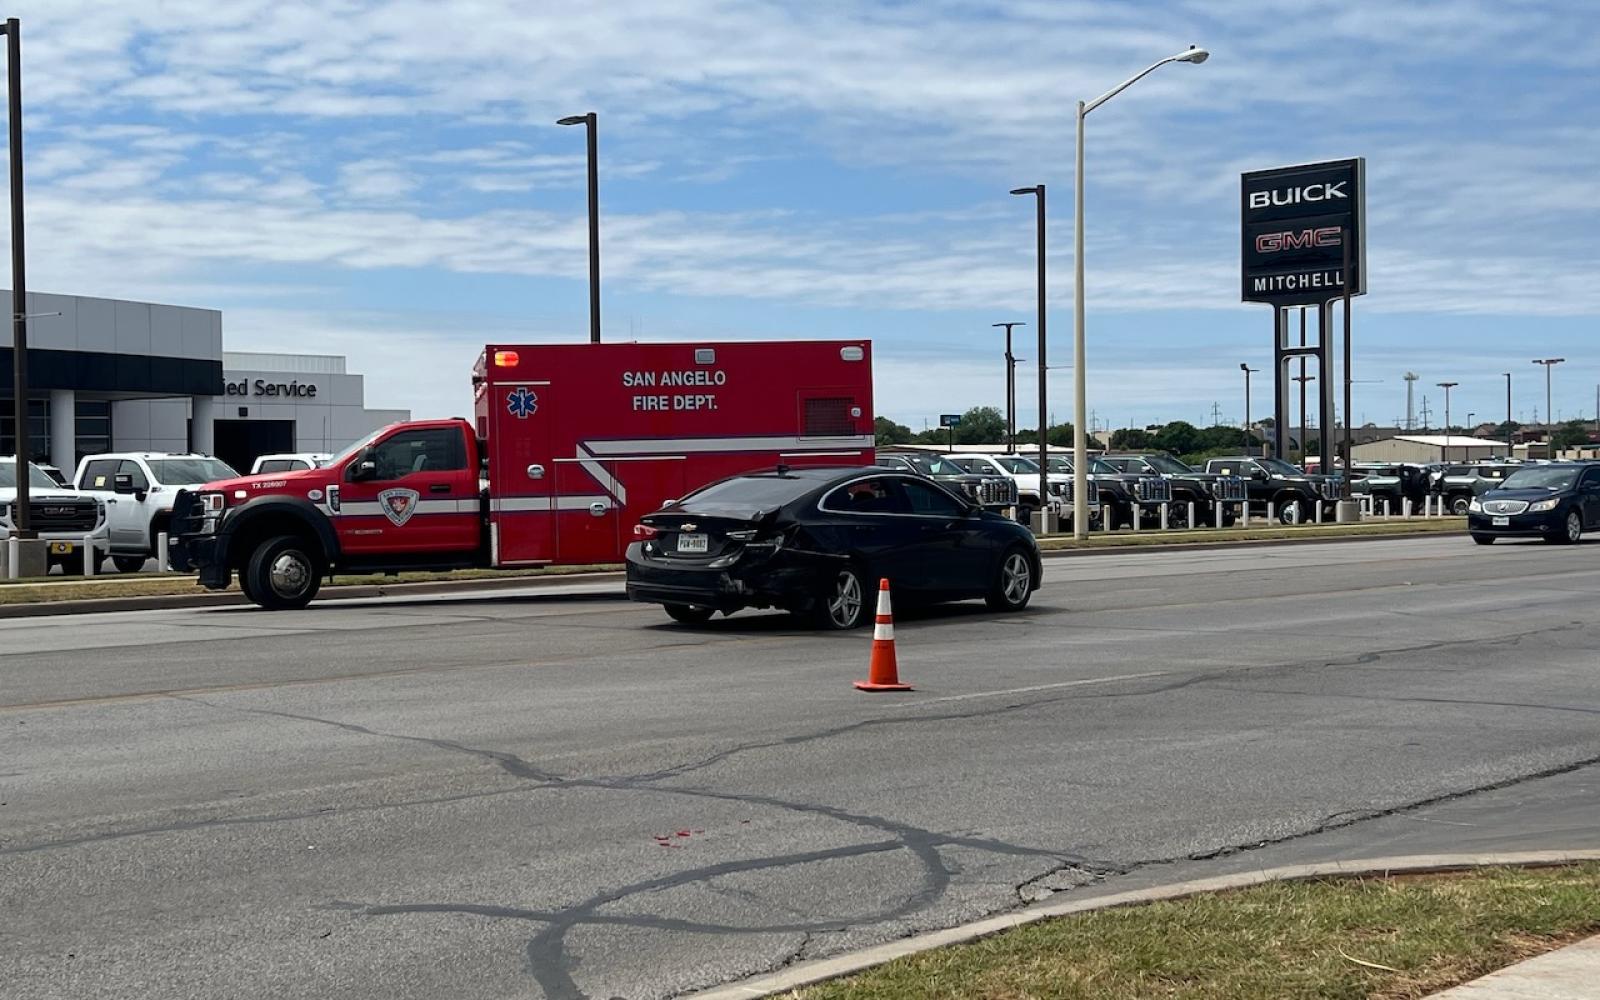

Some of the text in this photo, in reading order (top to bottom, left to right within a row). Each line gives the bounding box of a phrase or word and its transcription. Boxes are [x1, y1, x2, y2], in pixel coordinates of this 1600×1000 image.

[1249, 181, 1348, 209] BUICK
[1255, 226, 1342, 253] GMC
[1254, 271, 1345, 291] MITCHELL
[623, 370, 726, 386] SAN ANGELO
[254, 379, 317, 397] Service
[633, 395, 718, 411] FIRE DEPT.
